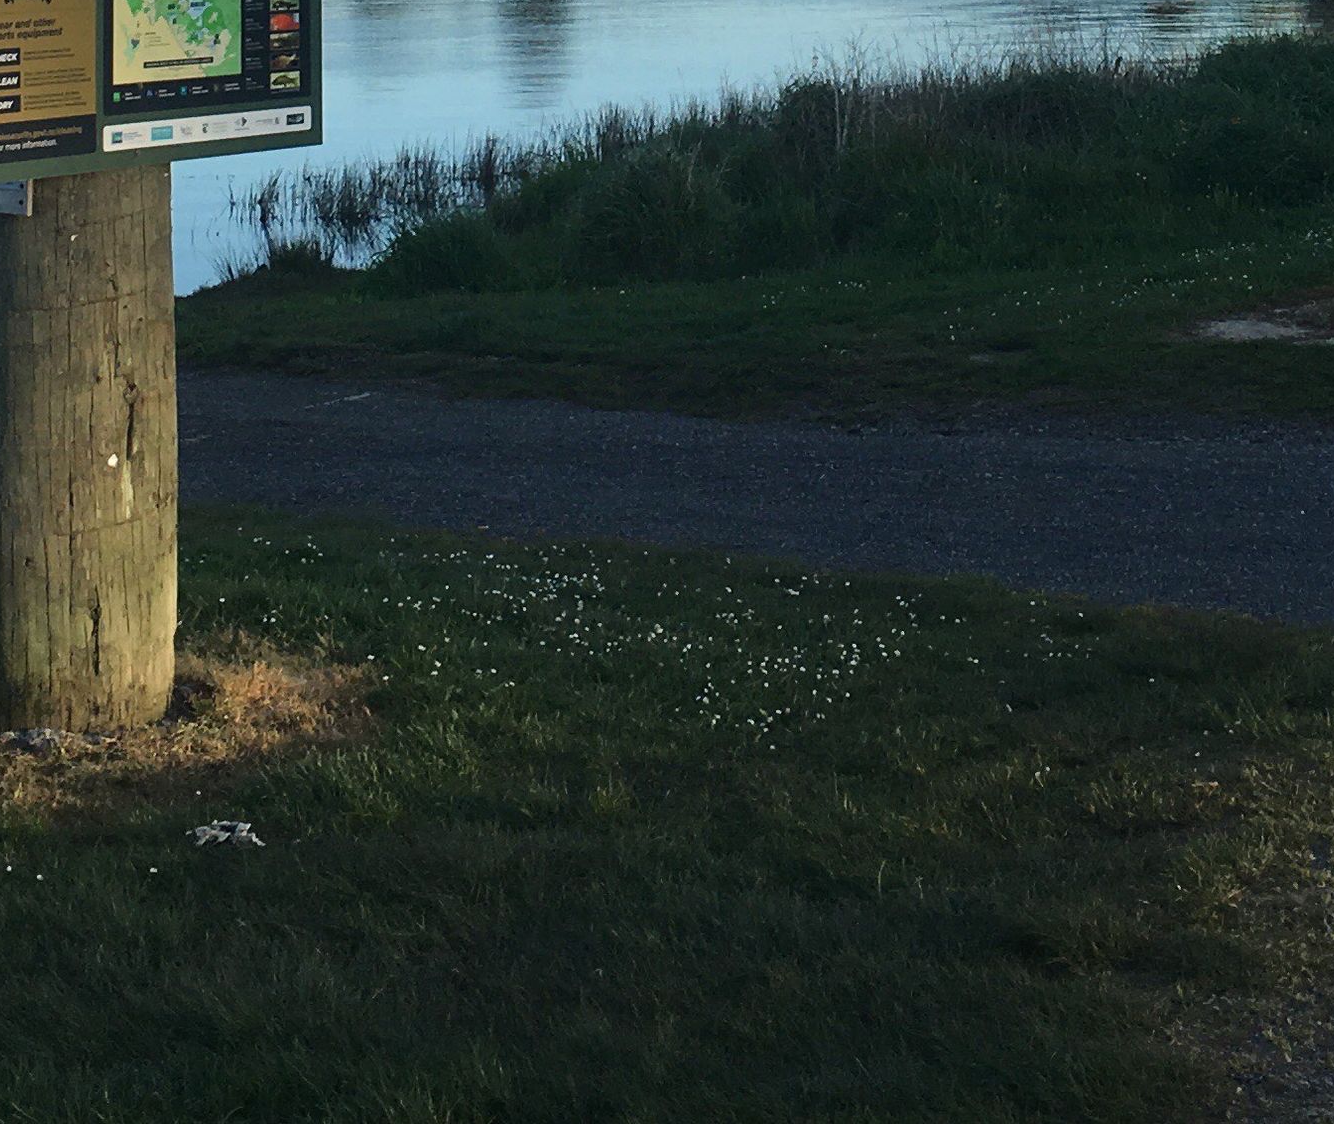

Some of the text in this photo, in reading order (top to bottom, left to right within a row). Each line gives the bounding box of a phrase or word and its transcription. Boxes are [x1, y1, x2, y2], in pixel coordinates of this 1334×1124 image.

[15, 19, 31, 28] and
[33, 18, 56, 27] other
[17, 27, 63, 40] equipment
[5, 141, 21, 151] more
